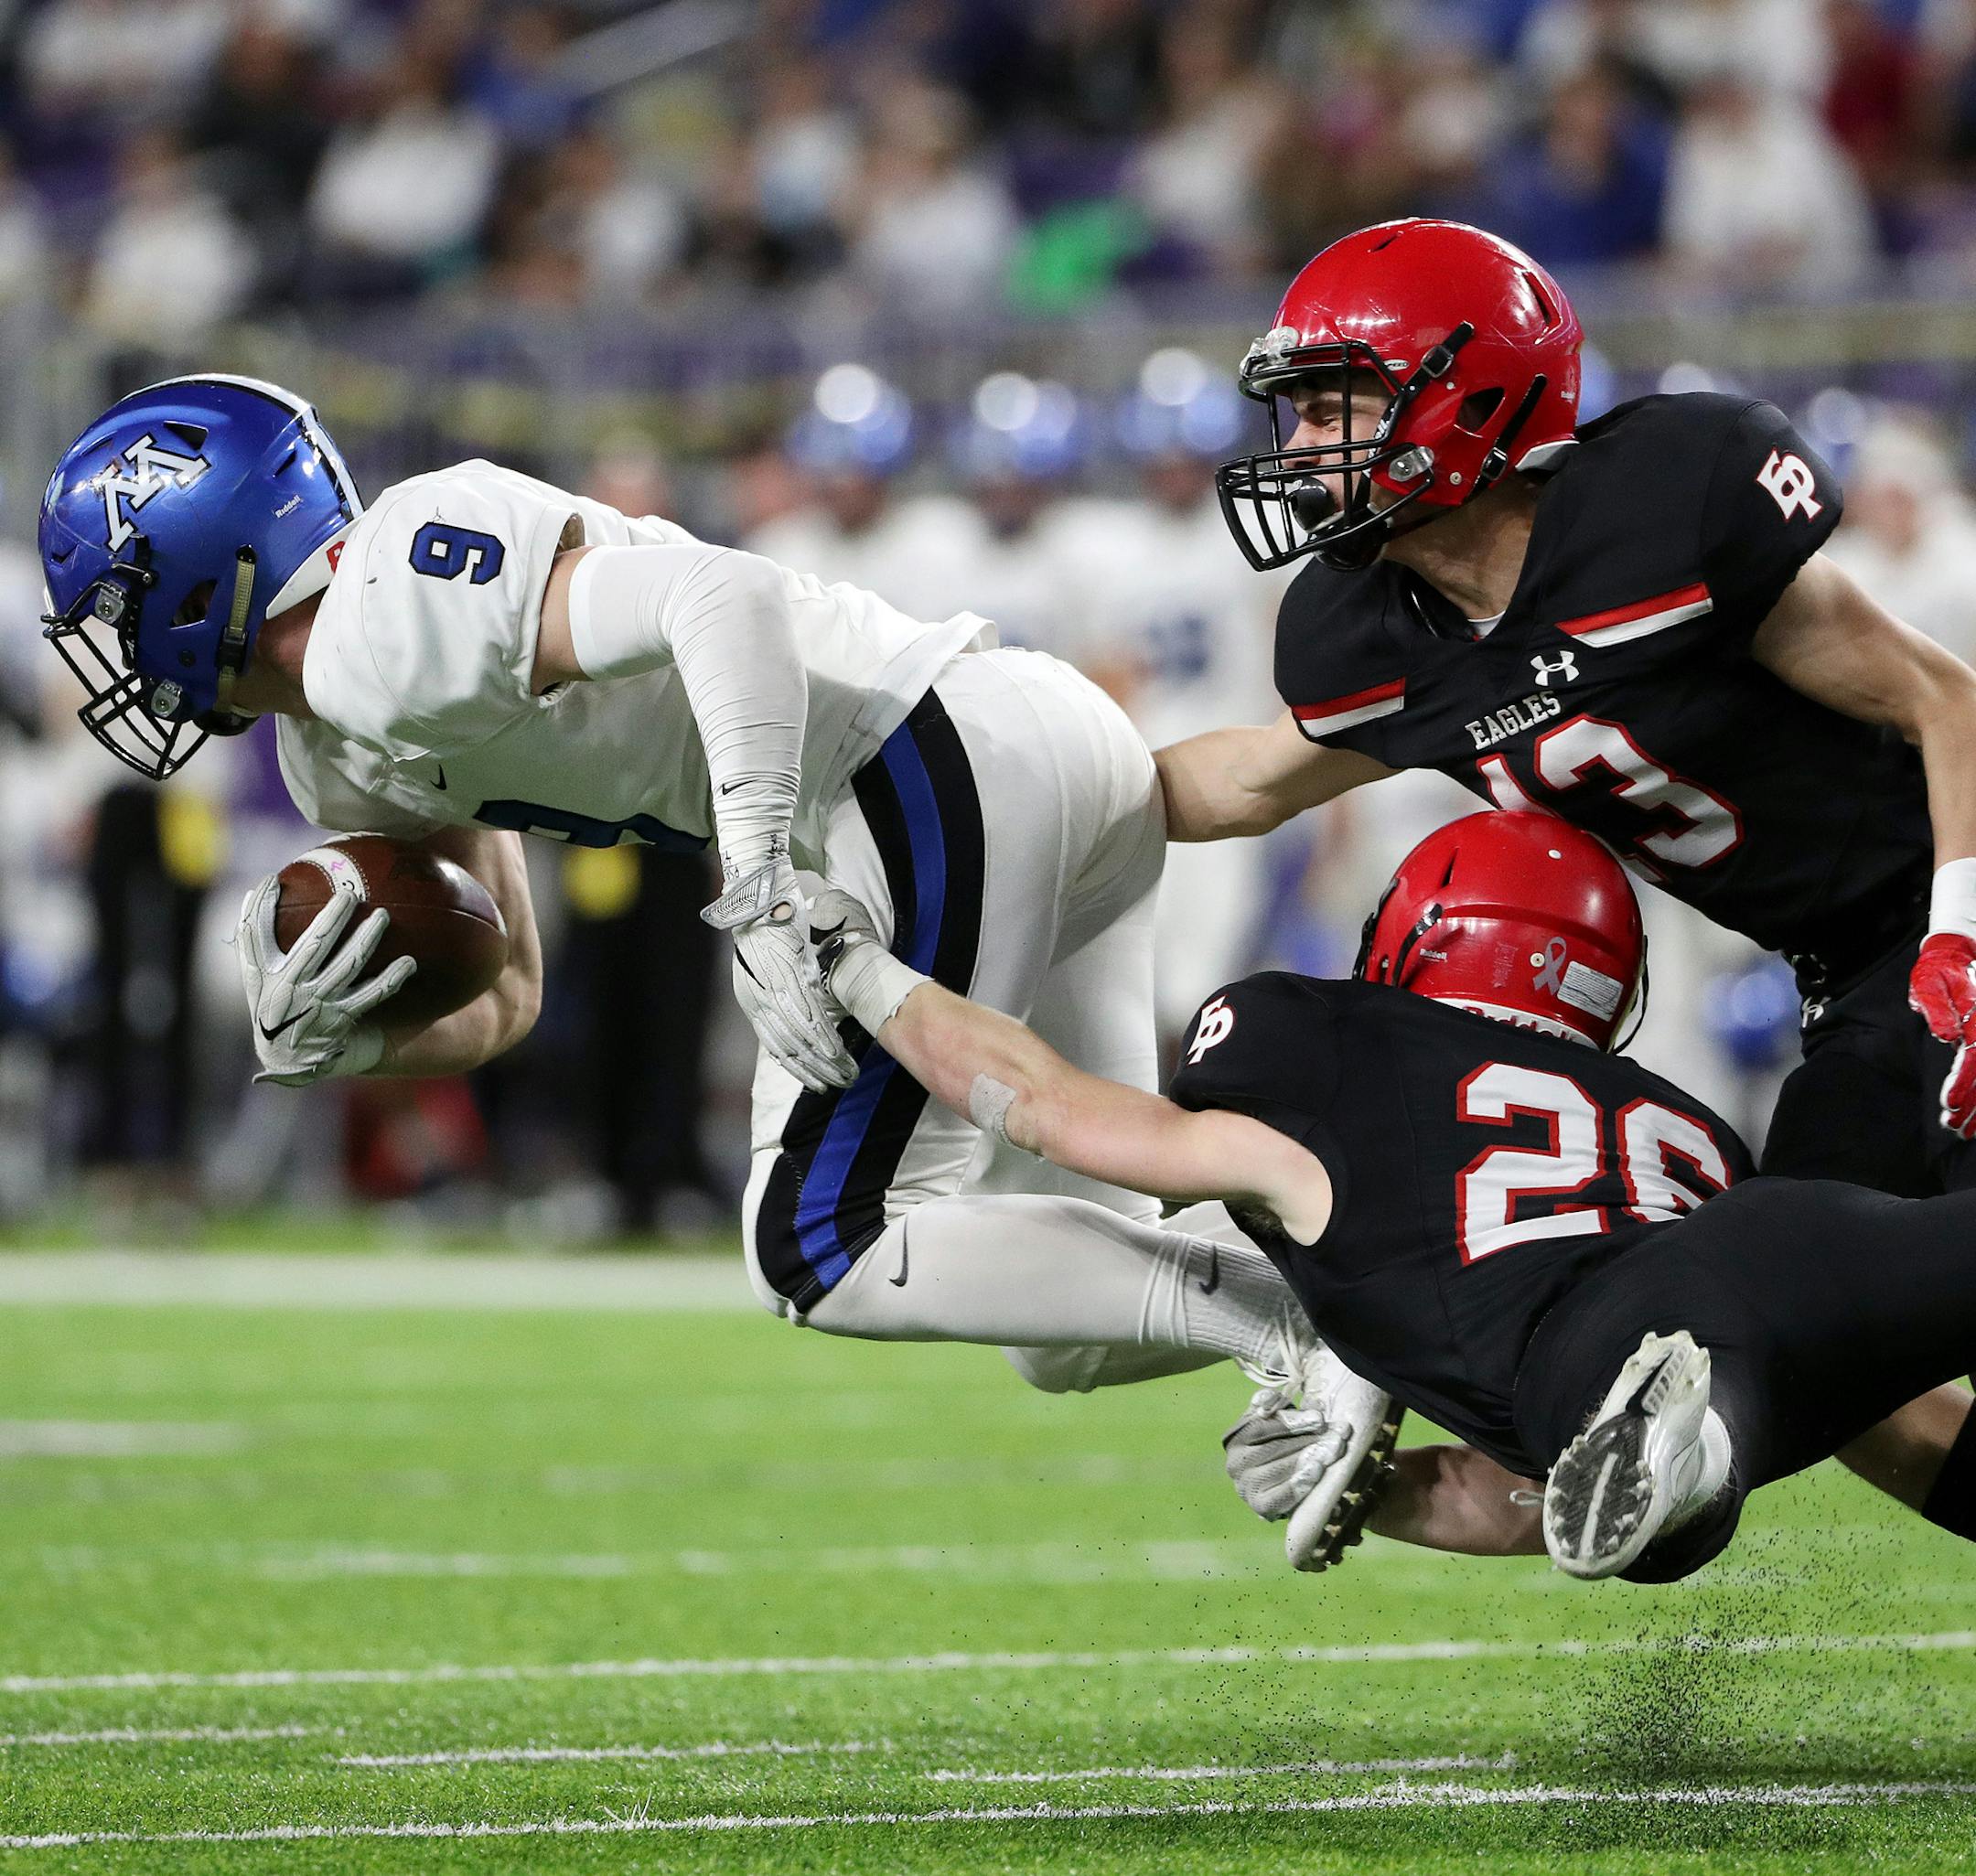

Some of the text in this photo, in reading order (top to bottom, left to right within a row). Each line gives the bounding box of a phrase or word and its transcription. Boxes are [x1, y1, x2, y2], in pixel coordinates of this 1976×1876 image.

[408, 521, 505, 584] 9
[1465, 691, 1562, 750] EAGLES
[1456, 1061, 1733, 1266] 26
